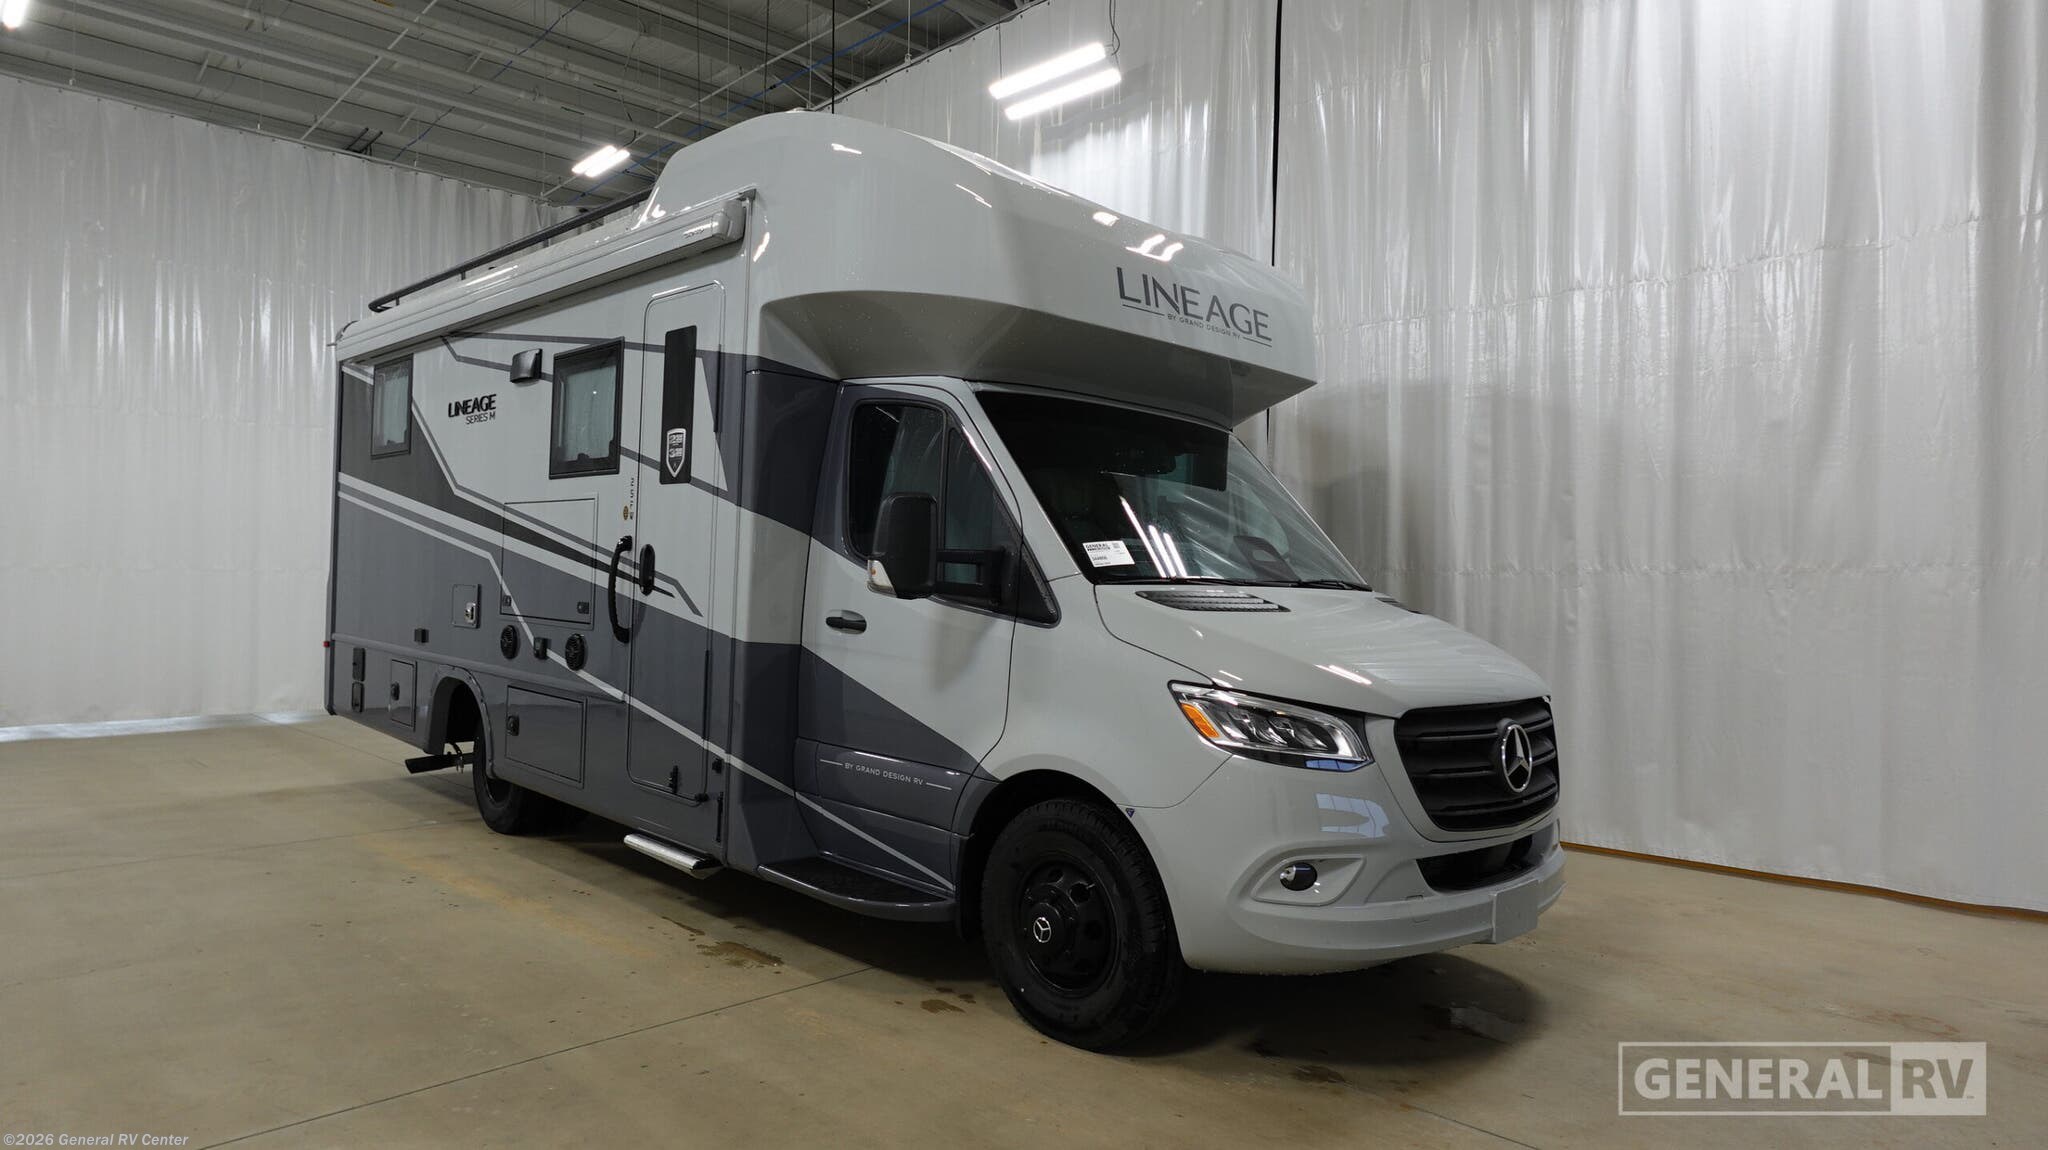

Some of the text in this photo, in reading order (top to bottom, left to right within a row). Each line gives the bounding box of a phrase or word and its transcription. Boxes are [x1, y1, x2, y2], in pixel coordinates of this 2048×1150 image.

[1116, 267, 1272, 341] LINEAGE
[1167, 313, 1177, 321] BY
[1180, 317, 1204, 329] GRAND
[1206, 324, 1231, 336] DESIGN
[448, 393, 497, 418] LINEAGE
[466, 411, 496, 425] SERIES M
[844, 762, 924, 785] BY GRAND DESIGN RV
